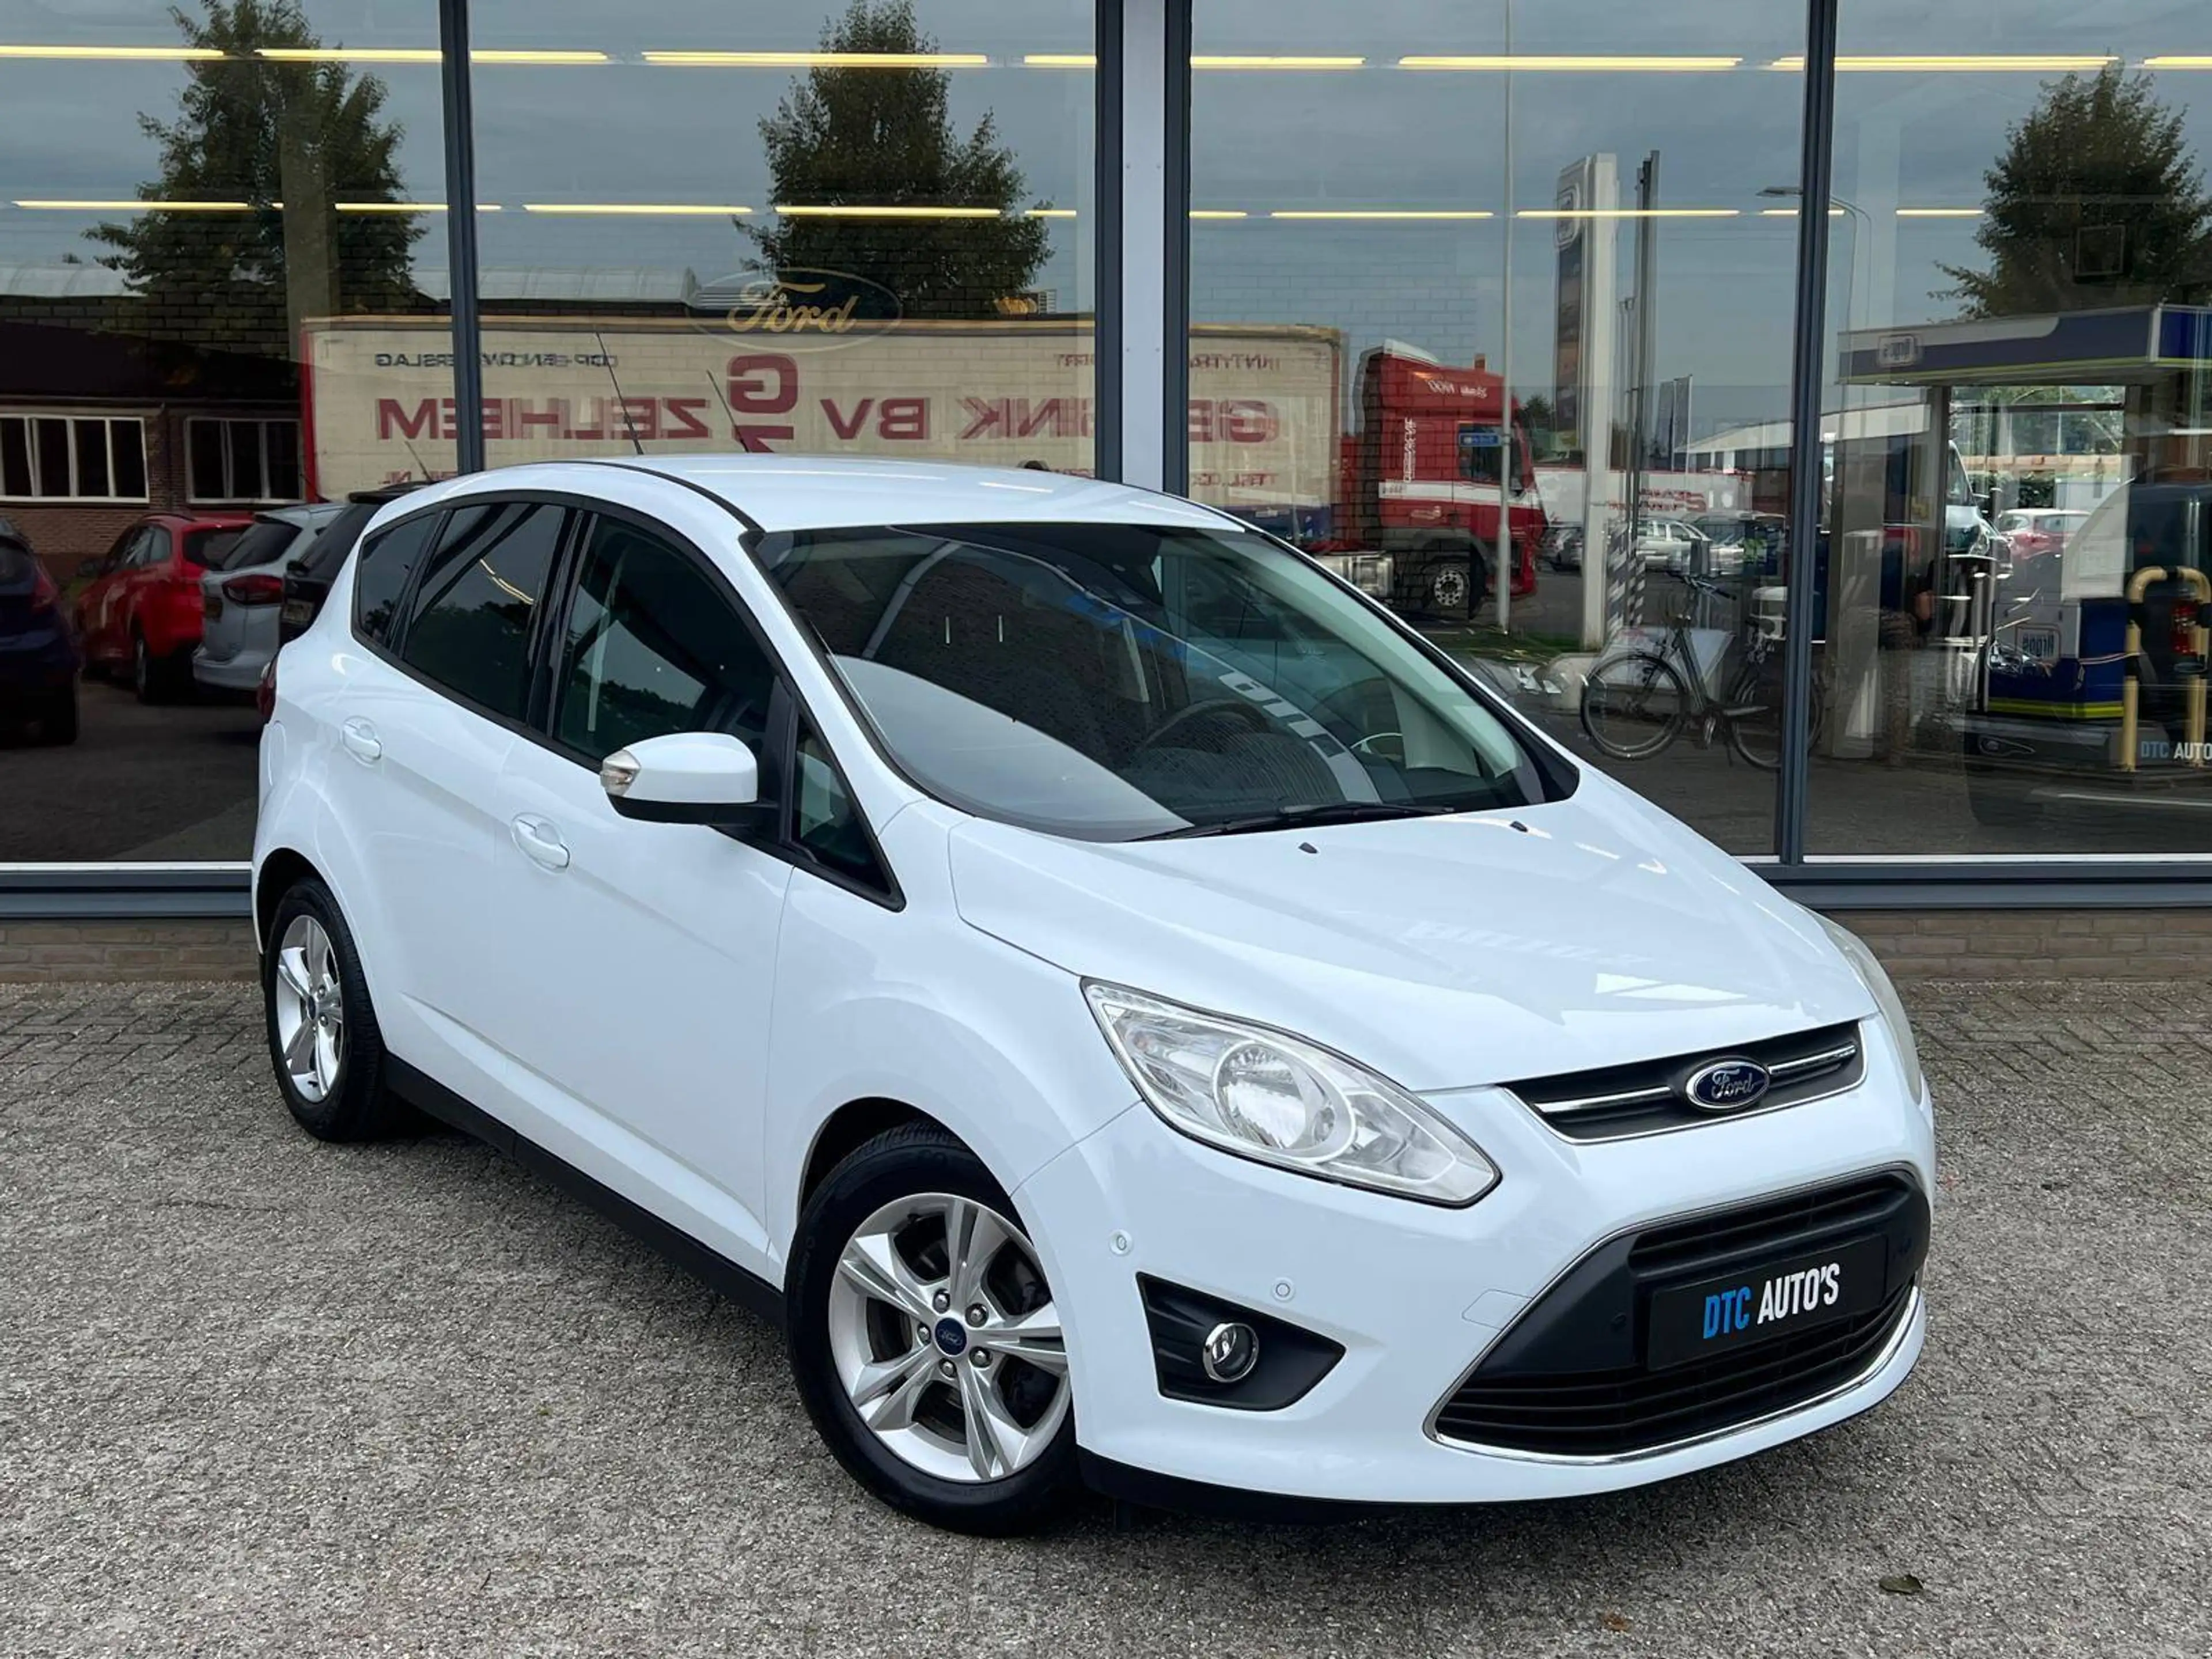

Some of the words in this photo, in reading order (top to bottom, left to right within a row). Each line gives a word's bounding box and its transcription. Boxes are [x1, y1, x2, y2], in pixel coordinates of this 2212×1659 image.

[726, 281, 860, 332] Ford
[2141, 741, 2169, 758] DTC
[1711, 1067, 1757, 1100] Ford
[1703, 1286, 1752, 1339] DTC
[1757, 1262, 1840, 1324] AUTO'S
